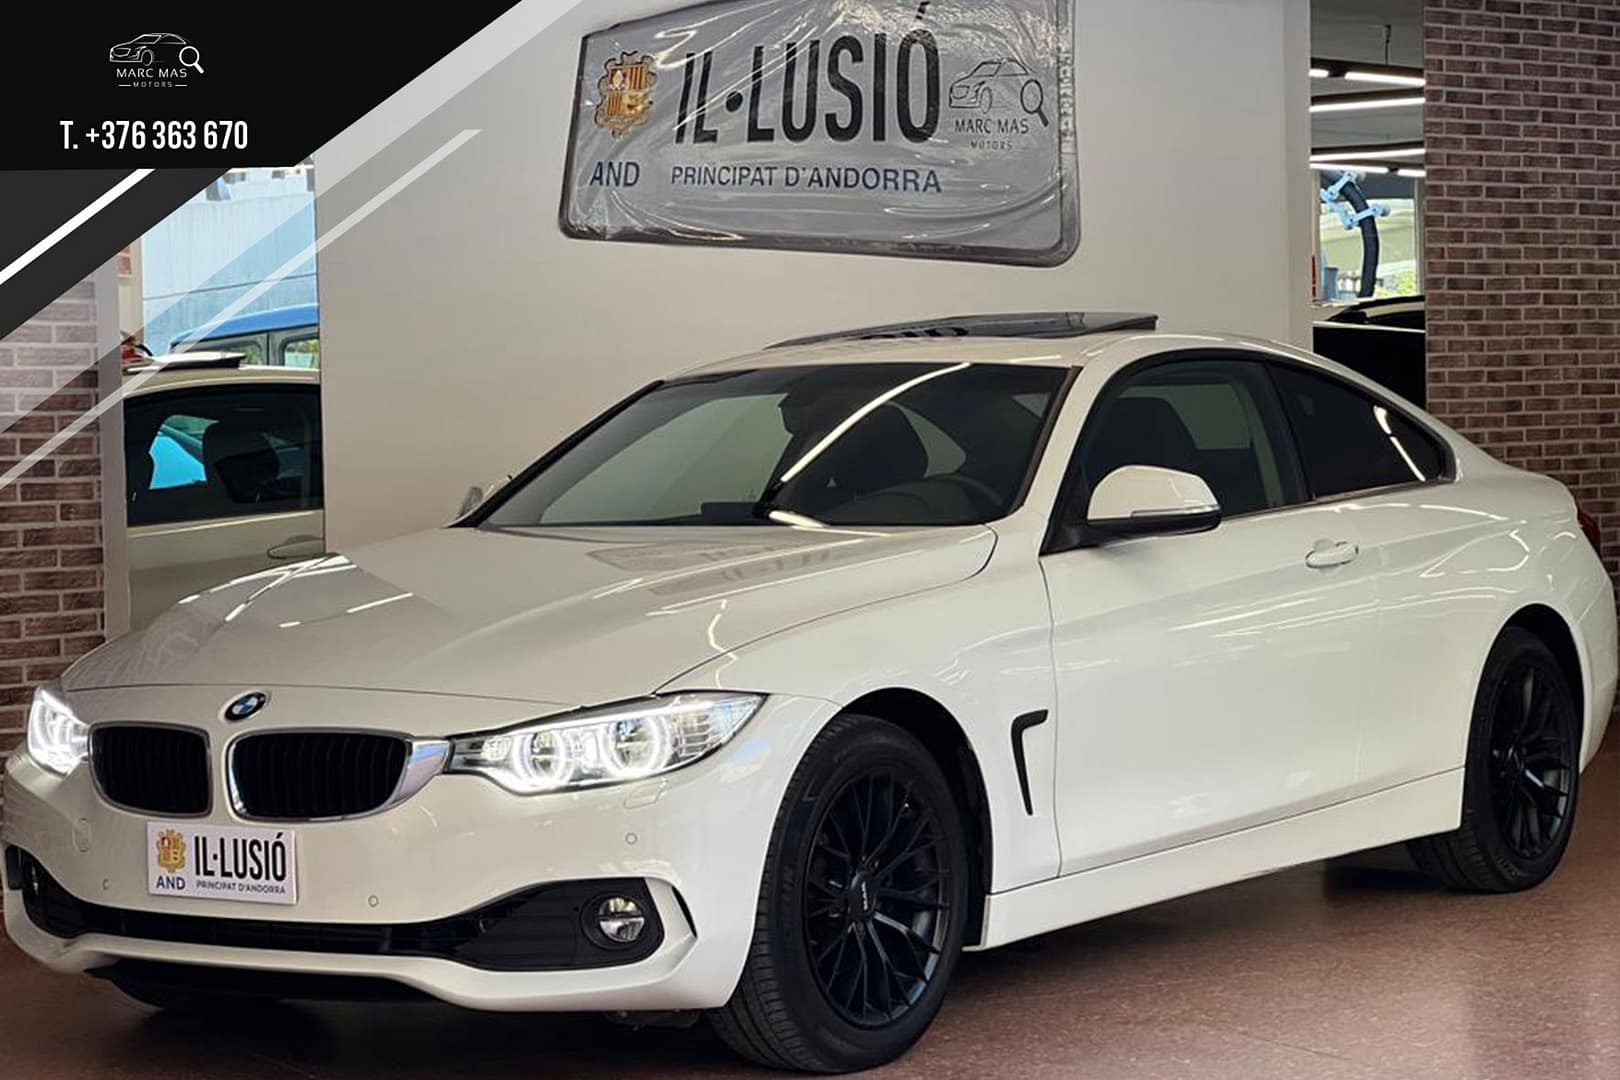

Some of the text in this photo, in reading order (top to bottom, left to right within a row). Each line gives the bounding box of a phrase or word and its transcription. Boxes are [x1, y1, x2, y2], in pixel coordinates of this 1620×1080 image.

[954, 117, 1030, 135] MARC MAS
[589, 161, 943, 194] AND PRINCIPAT D'ANDORRA
[194, 832, 286, 882] IL·LUSIÓ
[156, 875, 285, 894] AND PRINCIPAT D'ANDORRA
